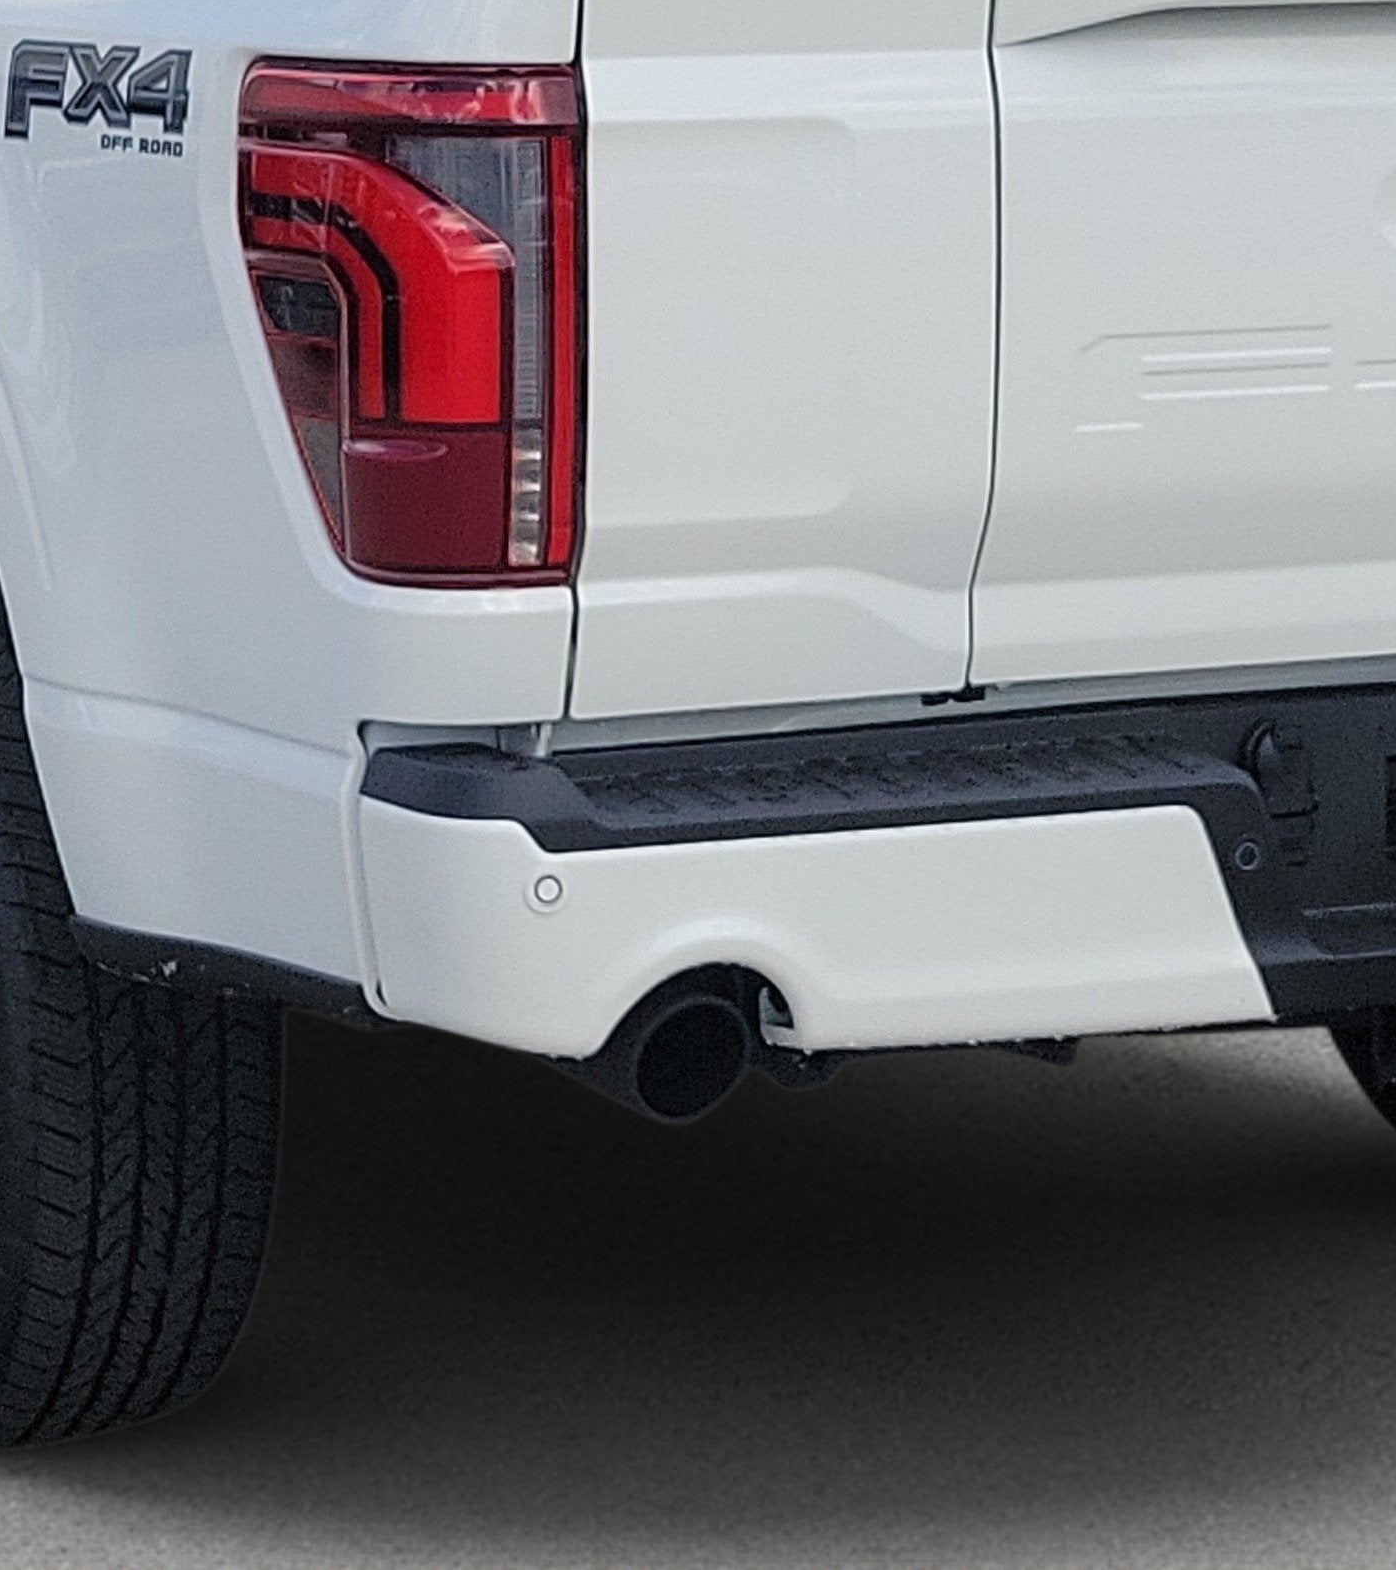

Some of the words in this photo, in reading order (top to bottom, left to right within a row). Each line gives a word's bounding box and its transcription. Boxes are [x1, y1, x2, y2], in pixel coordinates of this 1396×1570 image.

[3, 38, 193, 141] FX4
[100, 133, 134, 152] OFF
[138, 137, 184, 157] ROAD
